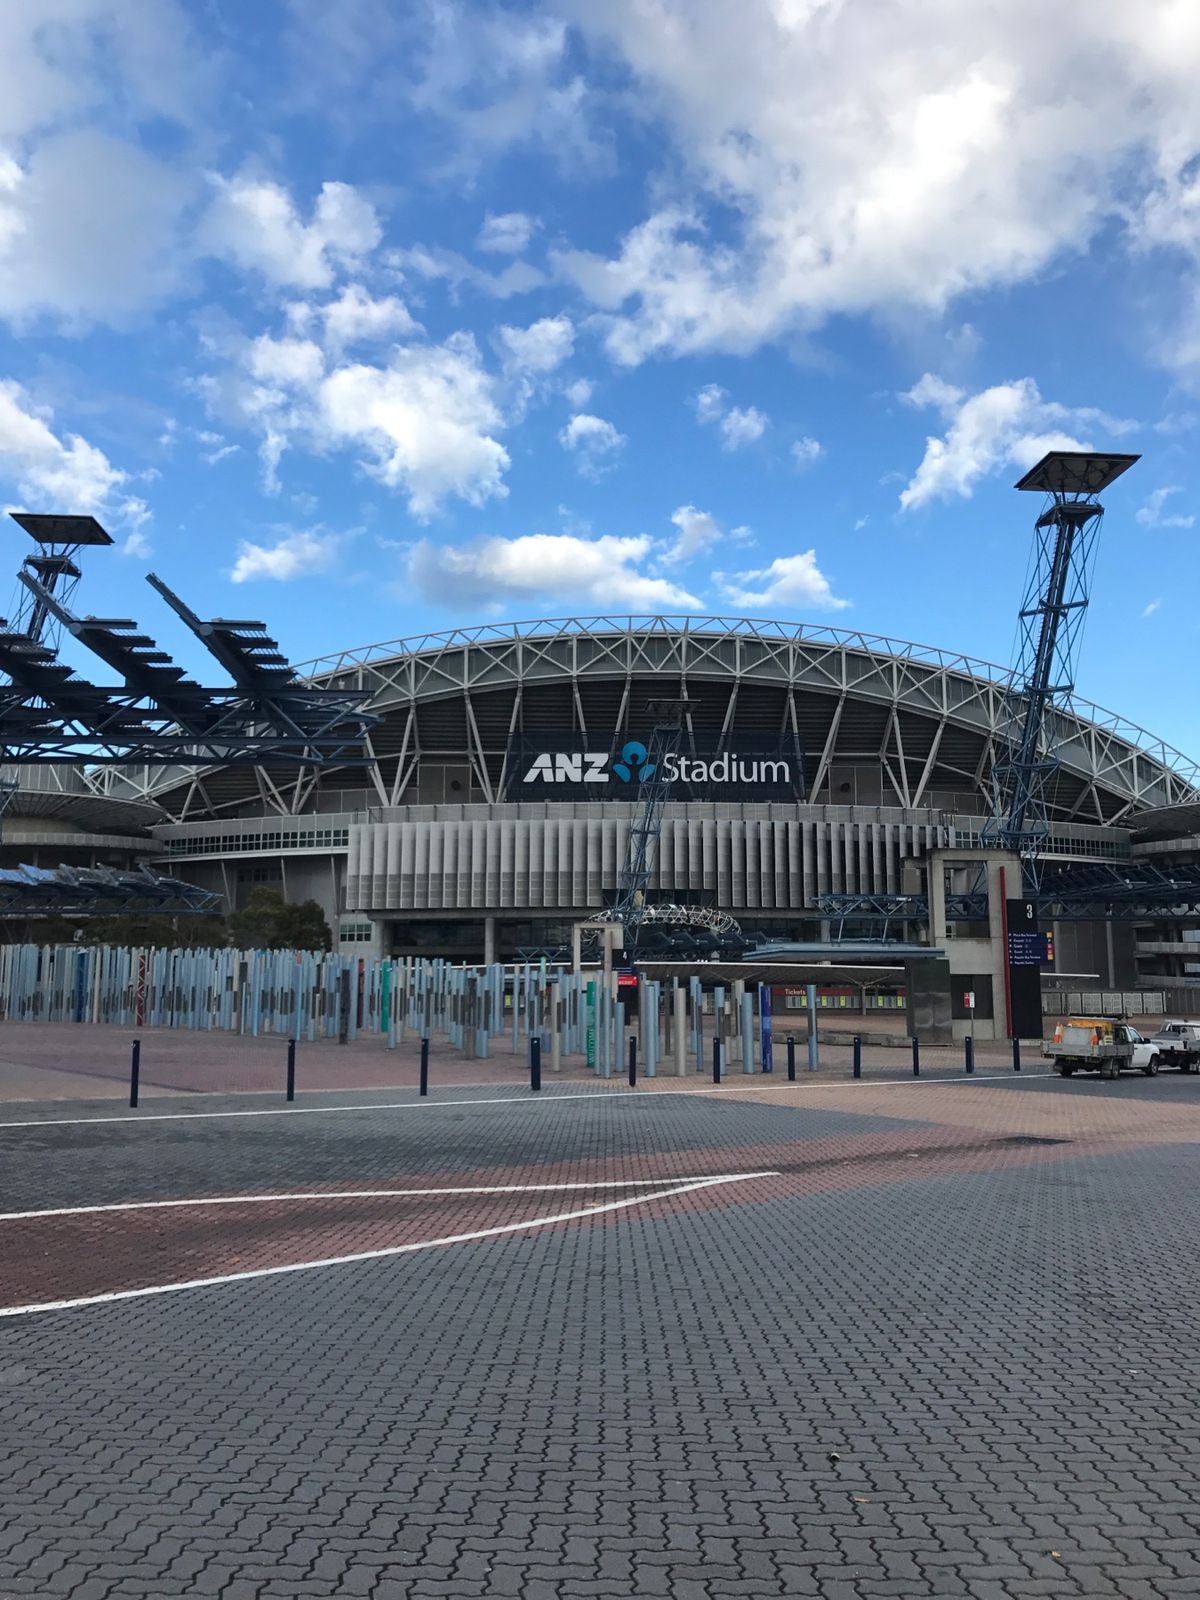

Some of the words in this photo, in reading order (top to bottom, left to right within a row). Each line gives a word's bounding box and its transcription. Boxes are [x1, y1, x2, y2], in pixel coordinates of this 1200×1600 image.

[523, 753, 609, 782] ANZ
[662, 751, 790, 783] Stadium
[1026, 904, 1033, 919] 3
[622, 951, 628, 960] 4
